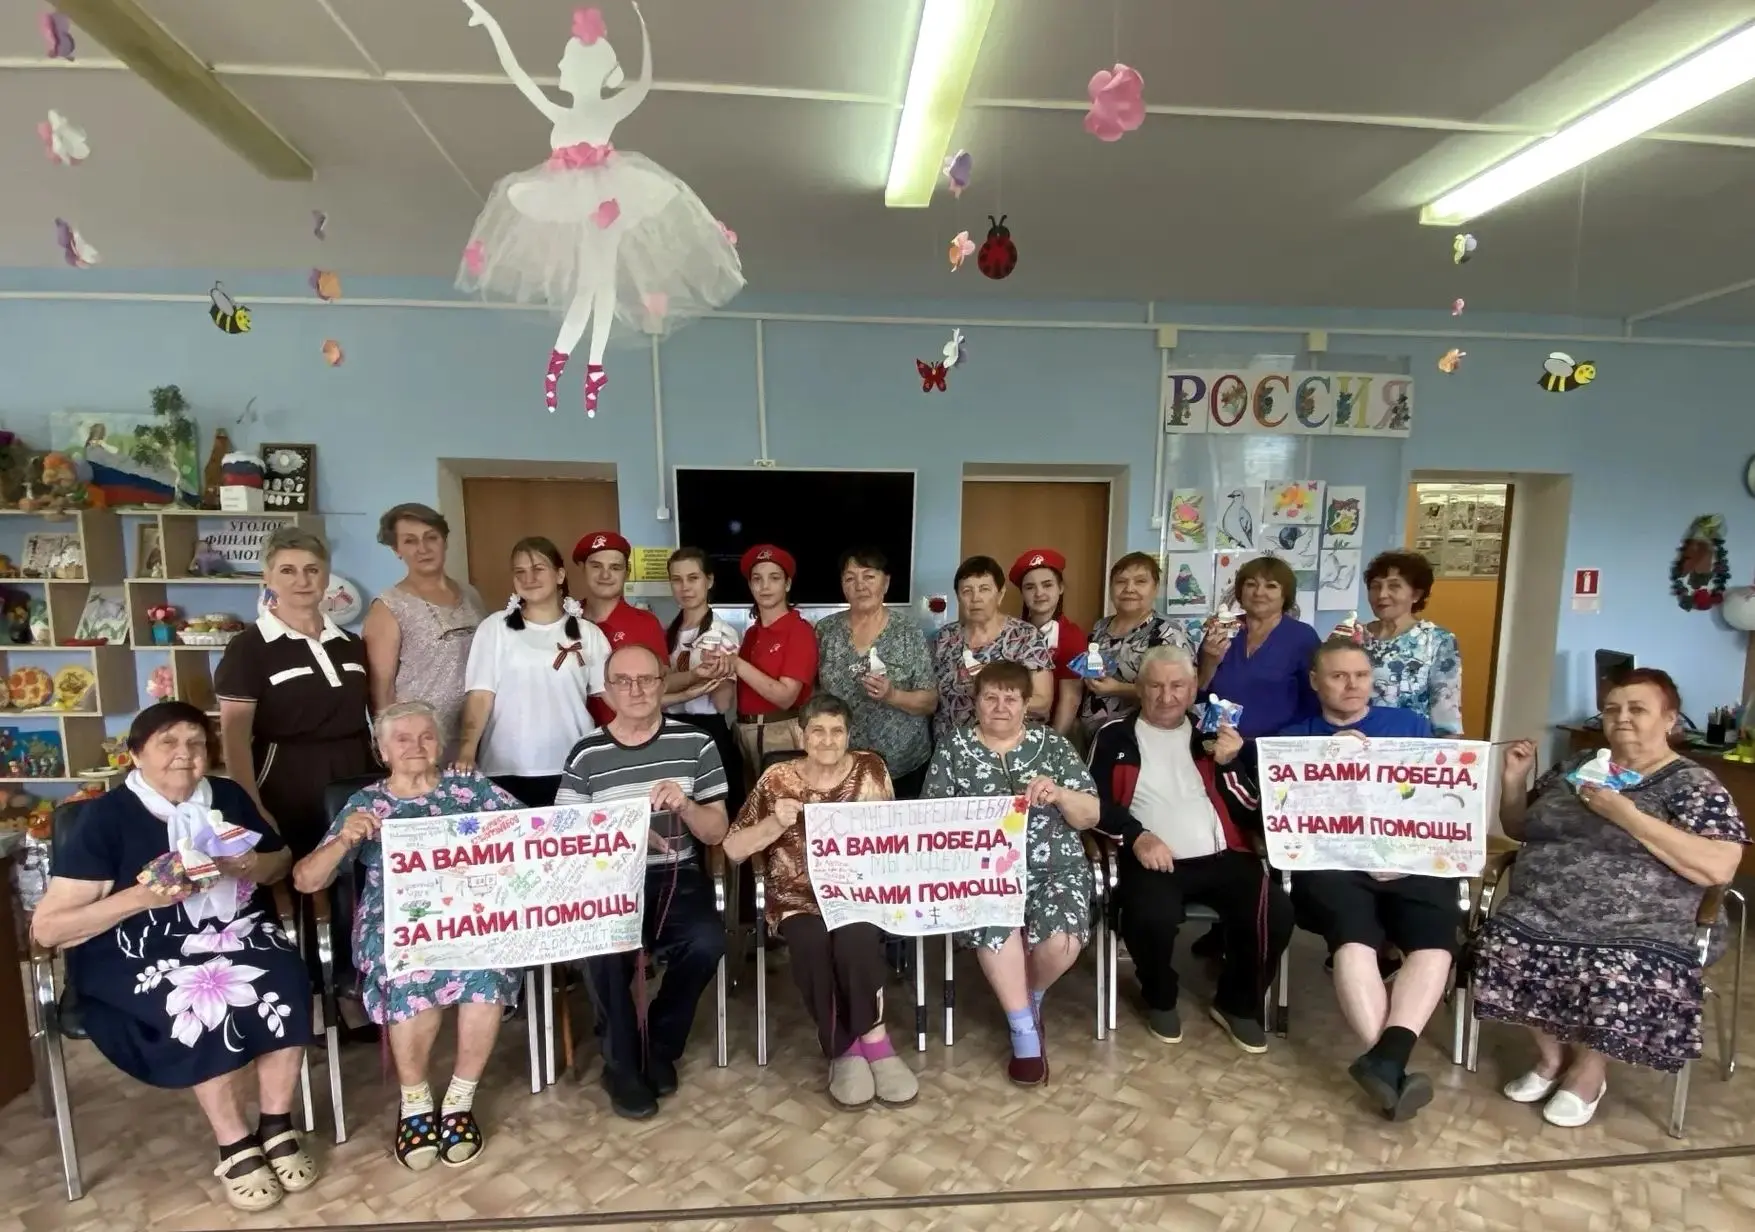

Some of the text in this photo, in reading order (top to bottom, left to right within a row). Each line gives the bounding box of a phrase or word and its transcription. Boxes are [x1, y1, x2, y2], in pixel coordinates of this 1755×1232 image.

[1167, 374, 1412, 431] РОССИЯ
[1268, 762, 1478, 790] ЗА ВАМИ ПОБЕДА,
[1266, 814, 1292, 833] ЗА
[1298, 815, 1364, 835] НАМИ
[390, 831, 637, 874] ЗА ВАМИ ПОБЕДА,
[811, 828, 1012, 857] ЗА ВАМИ ПОБЕДА,
[819, 884, 848, 900] ЗА
[849, 884, 912, 904] НАМИ
[393, 922, 432, 947] ЗА
[436, 910, 518, 941] НАМИ
